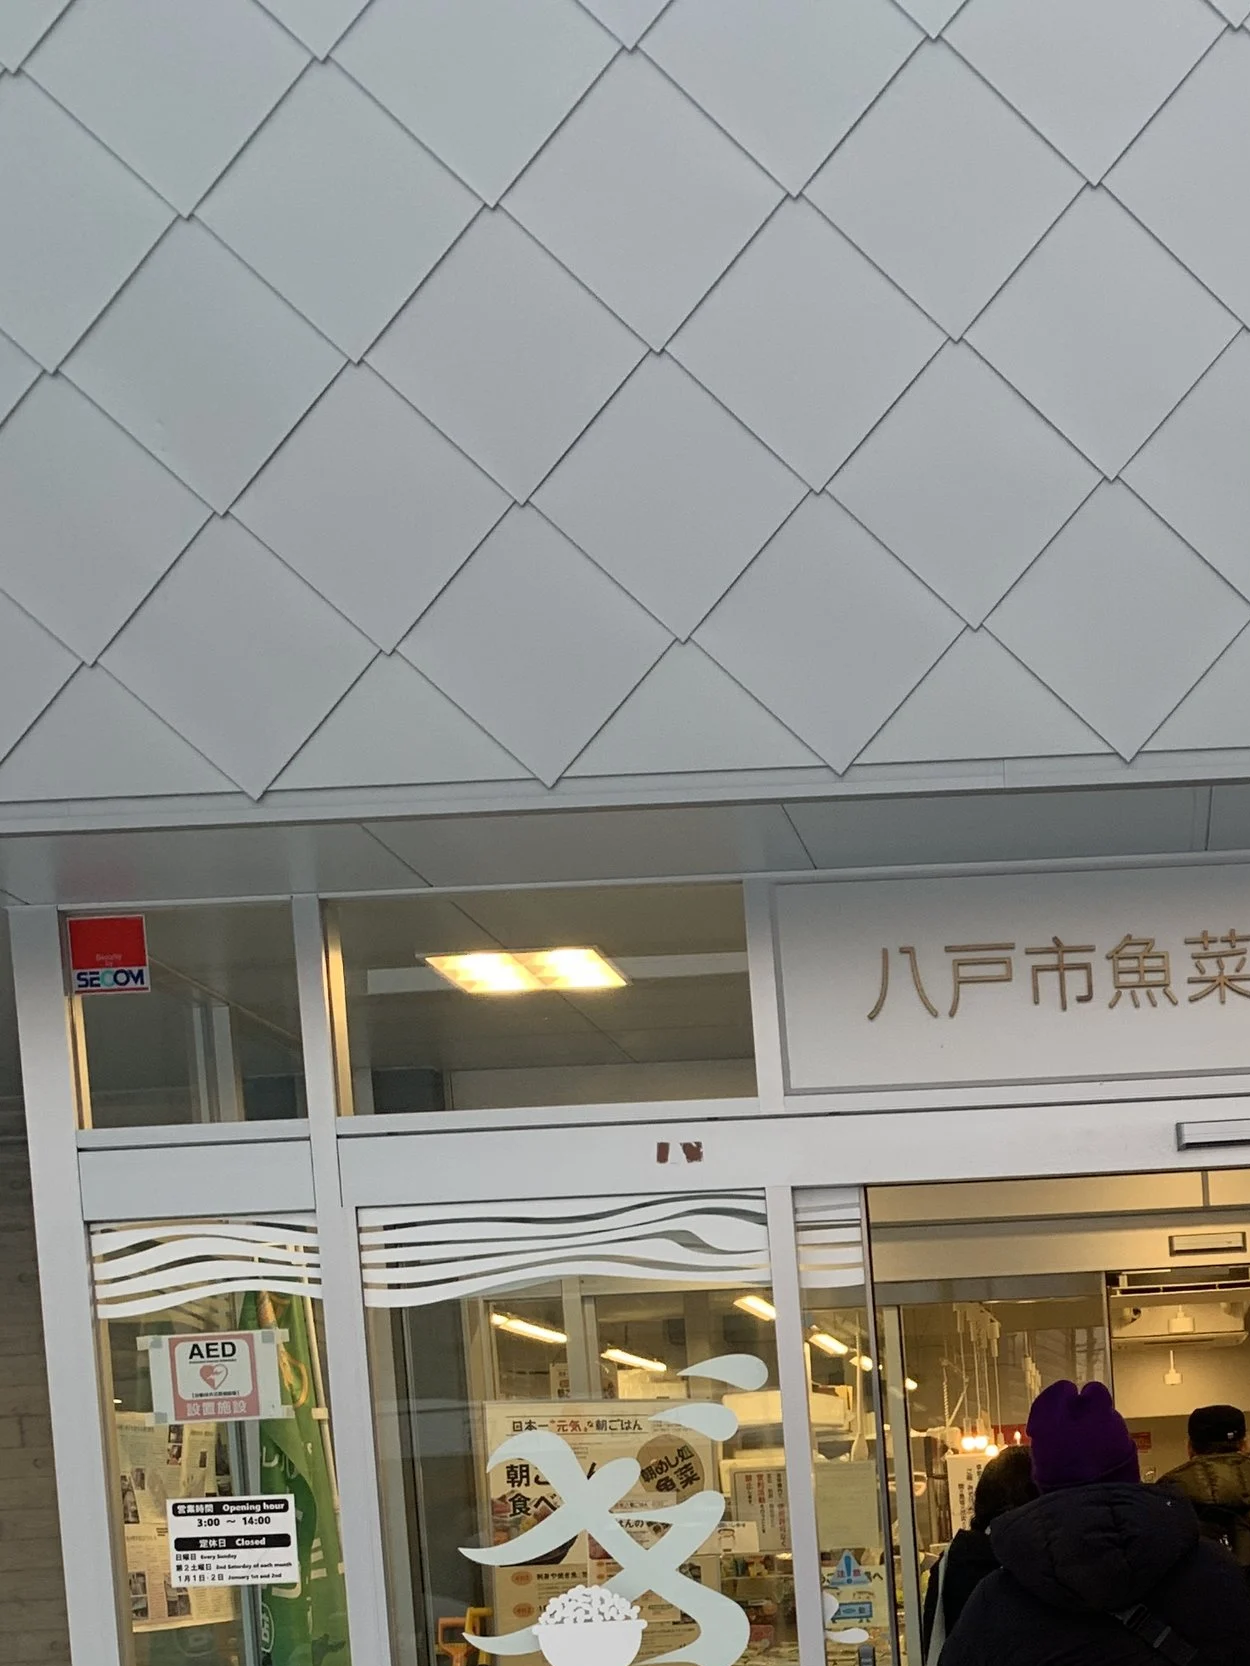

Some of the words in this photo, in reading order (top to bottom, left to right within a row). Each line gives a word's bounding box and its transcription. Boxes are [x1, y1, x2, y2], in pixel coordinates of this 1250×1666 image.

[76, 969, 145, 988] SECOM
[189, 1341, 237, 1360] AED
[187, 1400, 247, 1417] 設置施設
[177, 1504, 214, 1514] 営業時間
[222, 1503, 261, 1513] Opening
[263, 1502, 285, 1510] hour
[197, 1518, 220, 1527] 3:00
[242, 1516, 271, 1525] 14:00
[199, 1539, 226, 1548] 定休日
[235, 1537, 266, 1547] Closed
[175, 1553, 197, 1561] 日曜日
